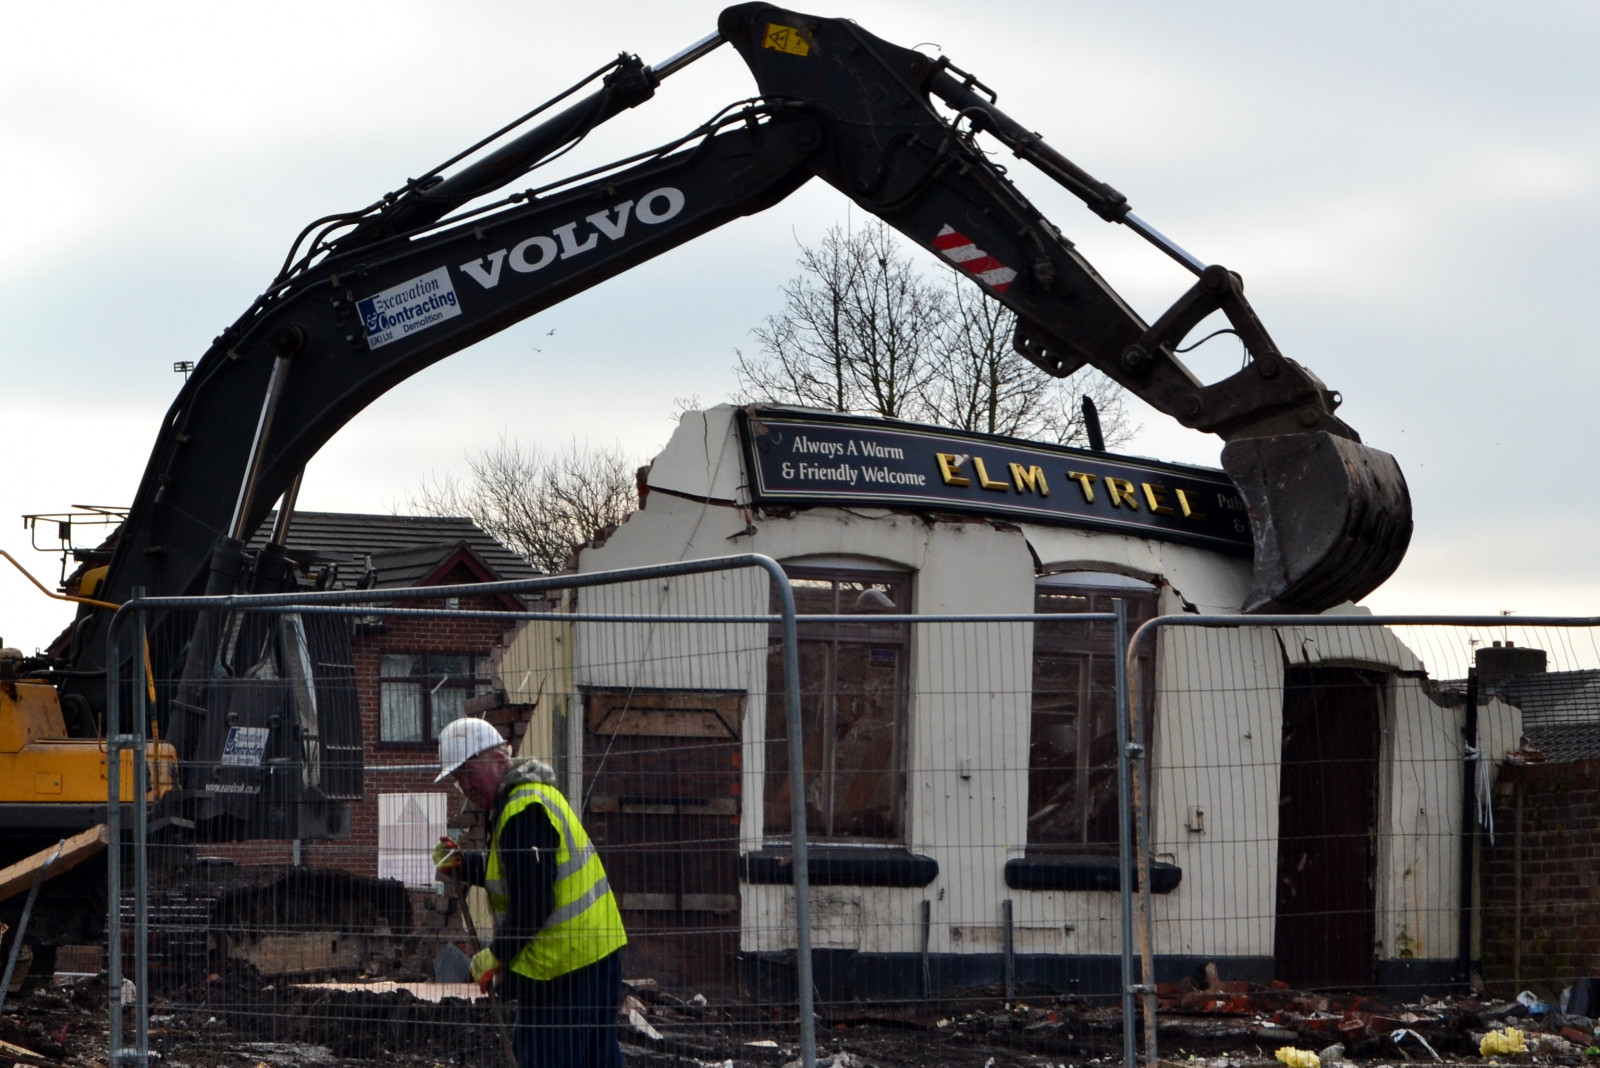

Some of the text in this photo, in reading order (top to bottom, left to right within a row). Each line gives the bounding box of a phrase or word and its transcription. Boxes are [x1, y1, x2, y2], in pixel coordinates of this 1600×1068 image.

[459, 187, 686, 290] VOLVO
[366, 290, 457, 331] & Contracting
[376, 278, 440, 311] Excavation
[382, 331, 393, 343] Ltd
[403, 311, 443, 333] Demolition
[792, 436, 904, 460] Always A Warm
[781, 462, 926, 486] & Friendly Welcome
[936, 452, 1208, 521] ELM TREE
